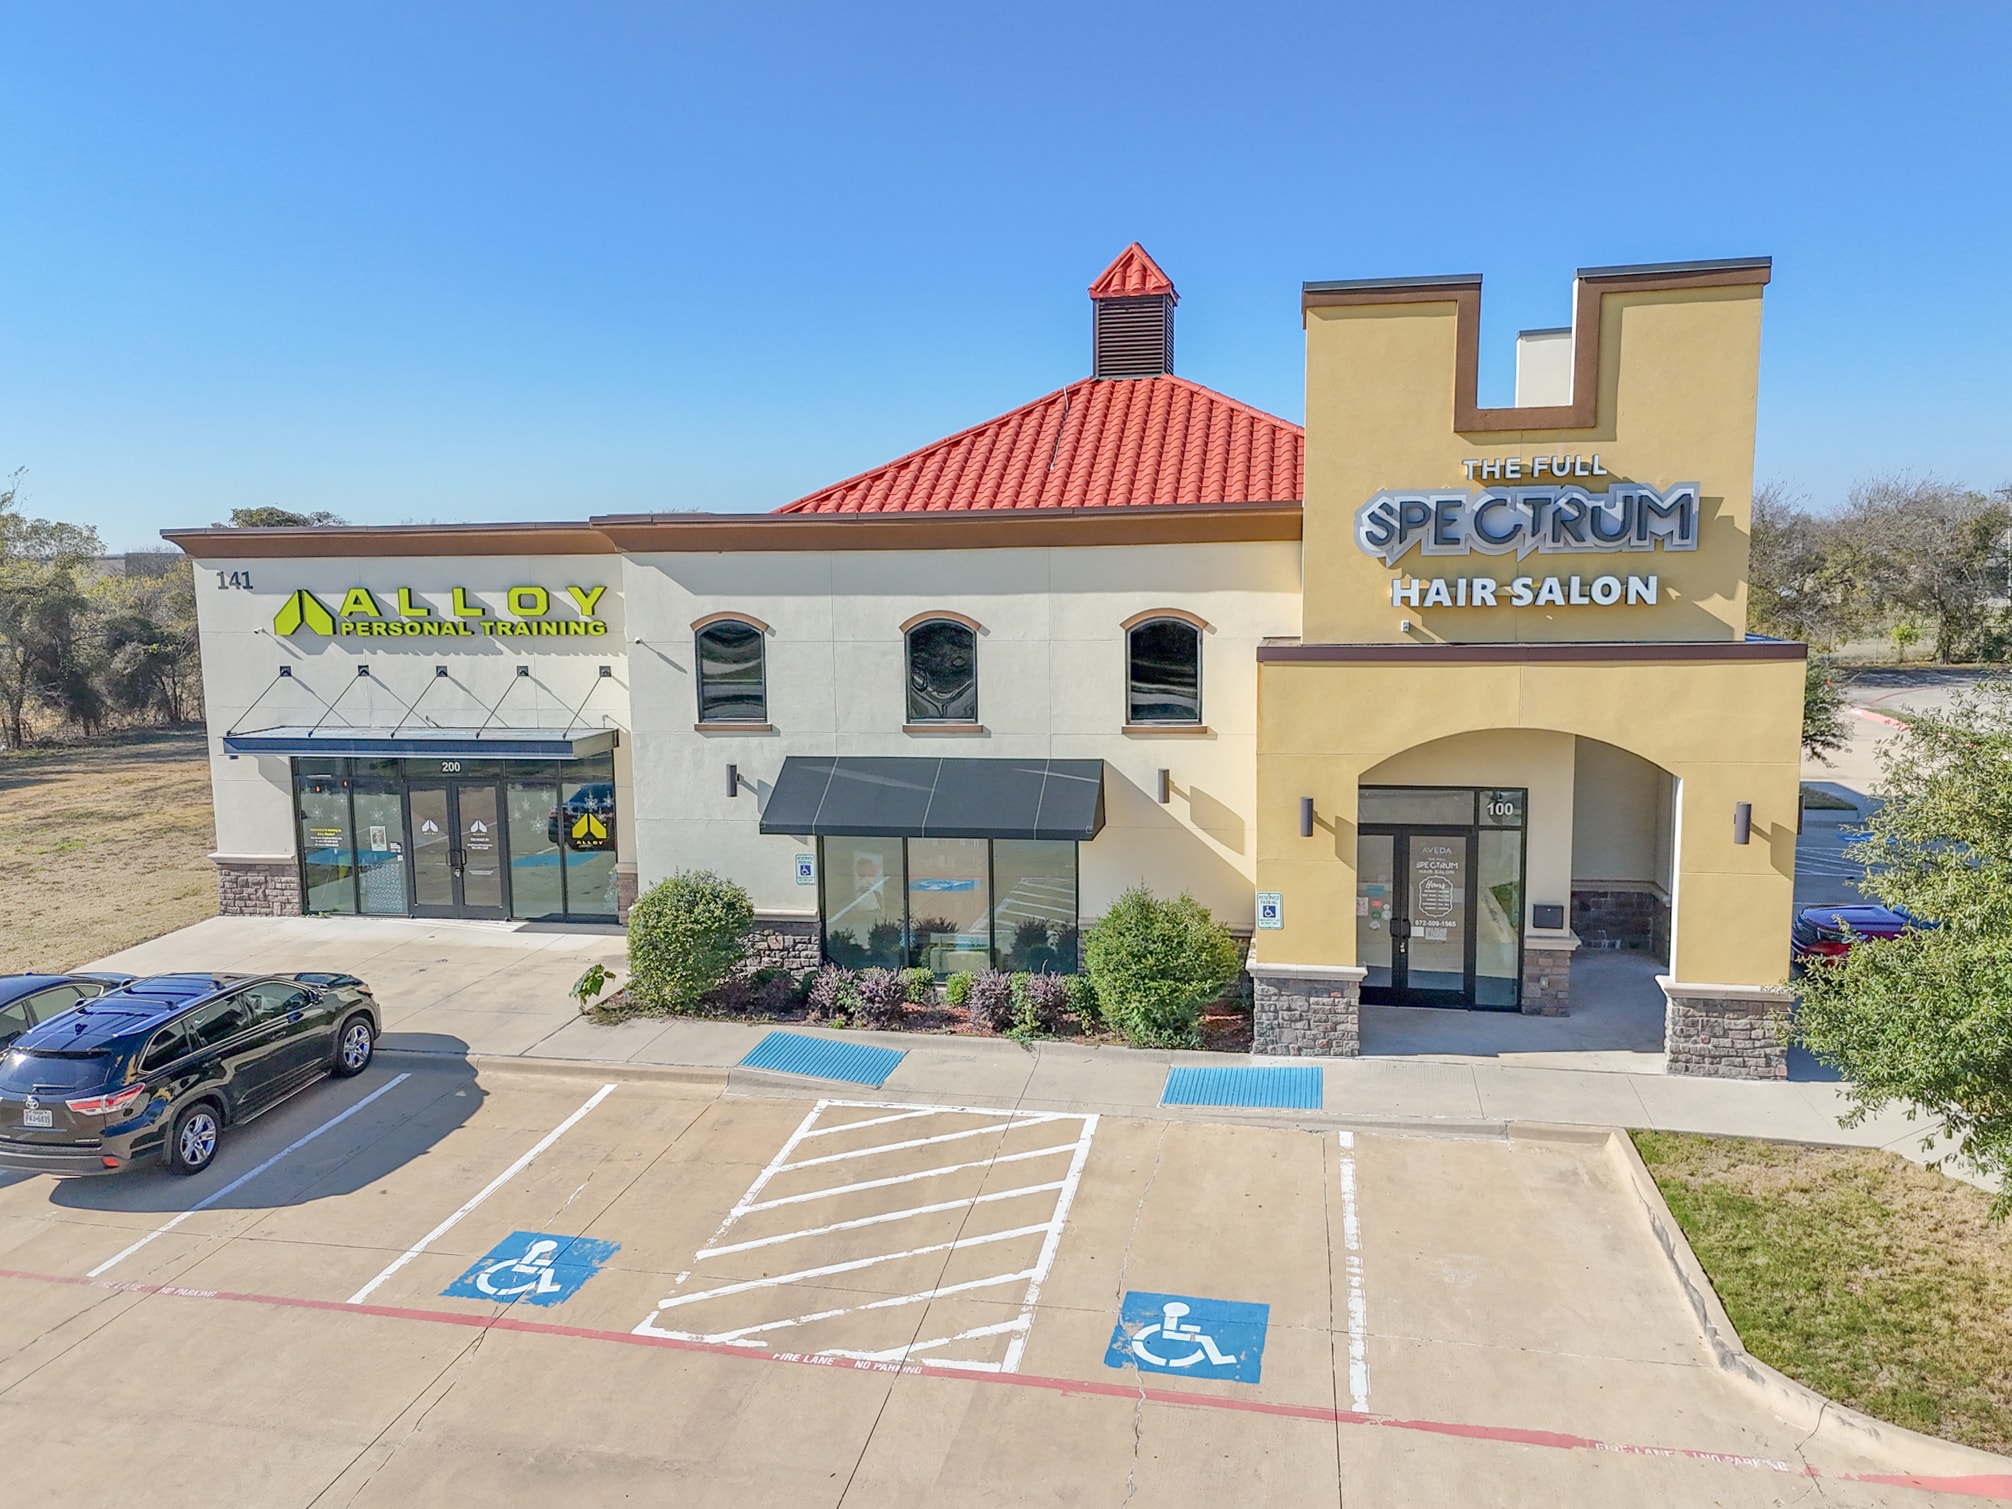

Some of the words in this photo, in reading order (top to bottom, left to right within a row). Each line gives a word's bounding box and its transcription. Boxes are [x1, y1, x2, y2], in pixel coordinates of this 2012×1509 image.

[1462, 457, 1522, 481] THE
[1532, 453, 1608, 478] FULL
[1360, 488, 1694, 550] SPECTRUM
[215, 570, 254, 591] 141
[1391, 577, 1498, 608] HAIR
[1510, 575, 1659, 606] SALON
[339, 584, 608, 618] ALLOY
[340, 620, 475, 637] PERSONAL
[482, 620, 608, 637] TRAINING
[442, 761, 461, 773] 200
[1486, 802, 1514, 816] 100
[1422, 846, 1453, 855] AVEDA
[1415, 861, 1459, 870] SPECTRUM
[772, 1352, 801, 1362] FIRE
[802, 1354, 836, 1366] LANE
[854, 1360, 871, 1370] NO
